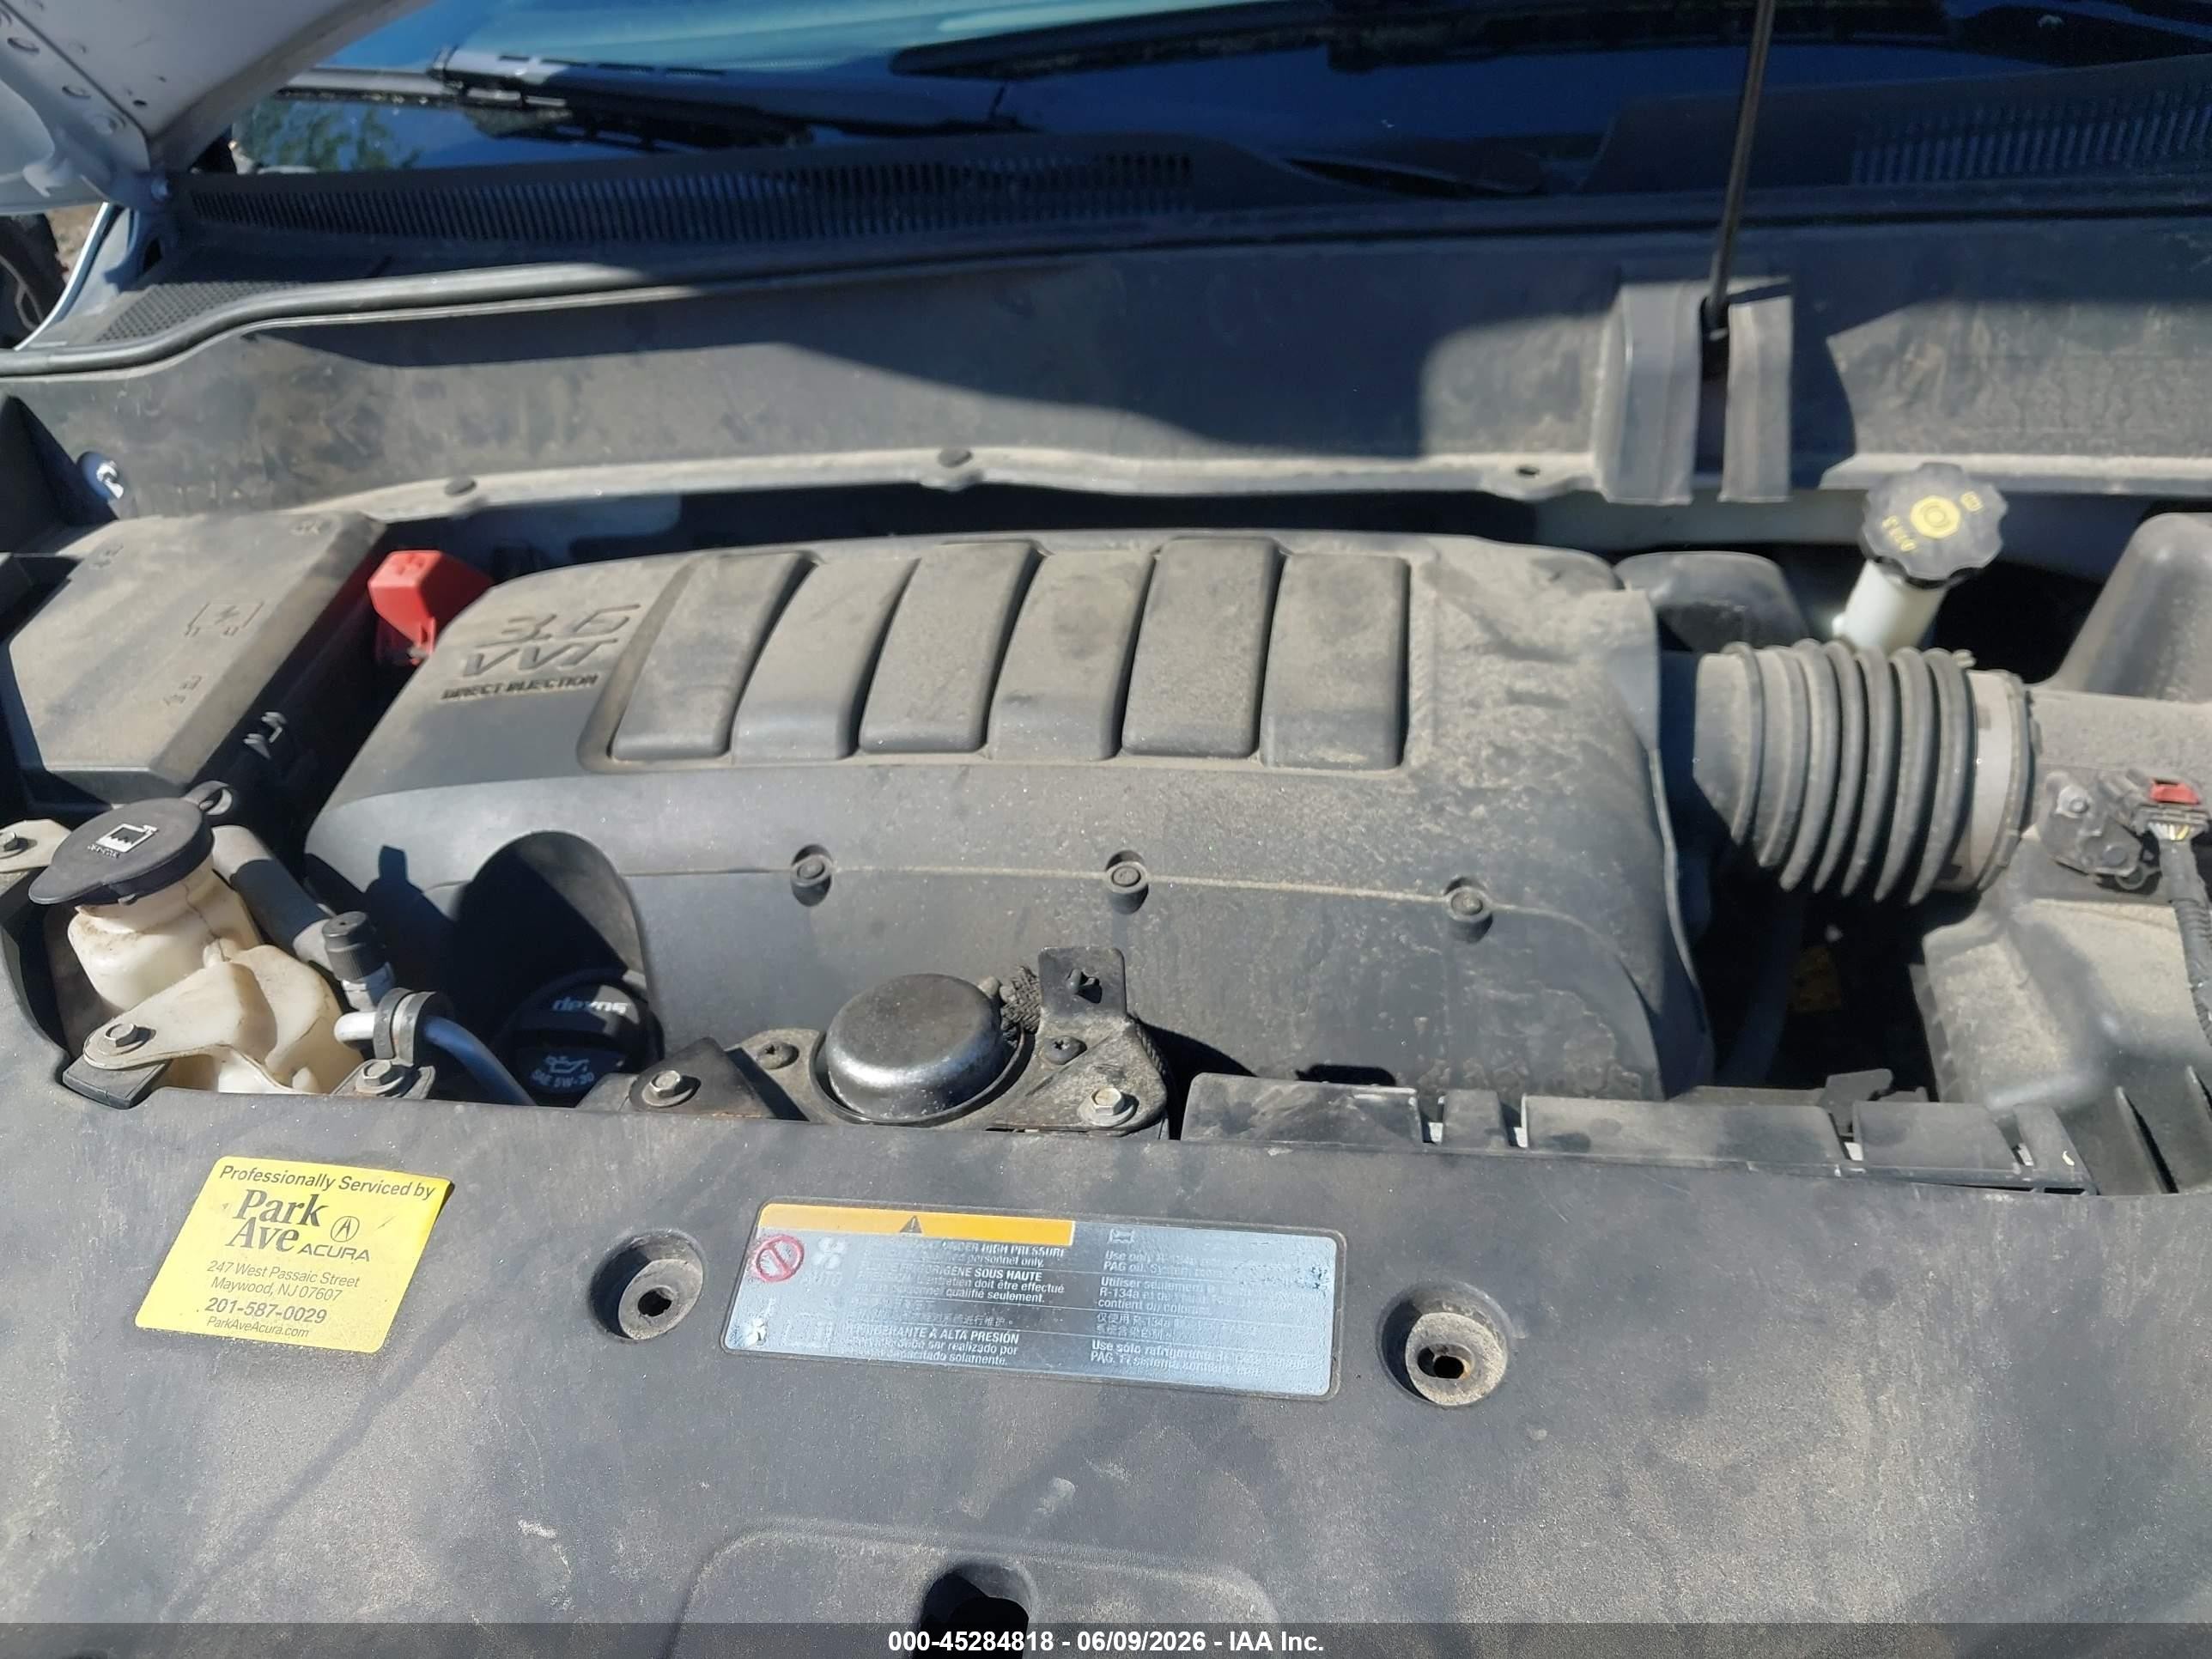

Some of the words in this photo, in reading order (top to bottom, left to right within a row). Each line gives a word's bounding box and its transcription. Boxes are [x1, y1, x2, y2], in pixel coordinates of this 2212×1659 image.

[474, 603, 641, 648] 3.6
[462, 637, 618, 678] VVT
[220, 1165, 336, 1192] Professionally
[338, 1176, 412, 1197] Serviced
[413, 1182, 435, 1200] by
[233, 1188, 329, 1227] Park
[225, 1216, 300, 1252] Ave
[297, 1243, 370, 1262] ACURA
[1021, 1257, 1044, 1268] only.
[1105, 1249, 1127, 1261] Use
[207, 1260, 234, 1273] 247
[235, 1262, 268, 1278] West
[268, 1266, 318, 1283] Passaic
[319, 1272, 360, 1287] Street
[1103, 1261, 1127, 1272] PAG
[975, 1268, 1004, 1279] SOUS
[1006, 1270, 1042, 1281] HAUTE
[1101, 1276, 1142, 1288] Utiliser
[210, 1276, 274, 1296] Maywood,
[276, 1283, 299, 1297] NJ
[299, 1285, 343, 1301] 07607
[974, 1279, 994, 1289] doit
[997, 1279, 1018, 1291] être
[1021, 1282, 1065, 1293] effectué
[1099, 1286, 1139, 1299] R-134a
[945, 1287, 984, 1298] qualifié
[987, 1291, 1045, 1303] seulement.
[204, 1297, 327, 1324] 201-587-0029
[1097, 1299, 1143, 1310] contient
[207, 1316, 309, 1338] ParkAveAcura.com
[940, 1328, 968, 1340] ALTA
[970, 1330, 1019, 1345] PRESIÓN
[948, 1341, 997, 1354] realizado
[1000, 1346, 1018, 1356] por
[1091, 1339, 1114, 1351] Use
[949, 1352, 1008, 1365] solamente.
[1091, 1351, 1115, 1364] PAG.
